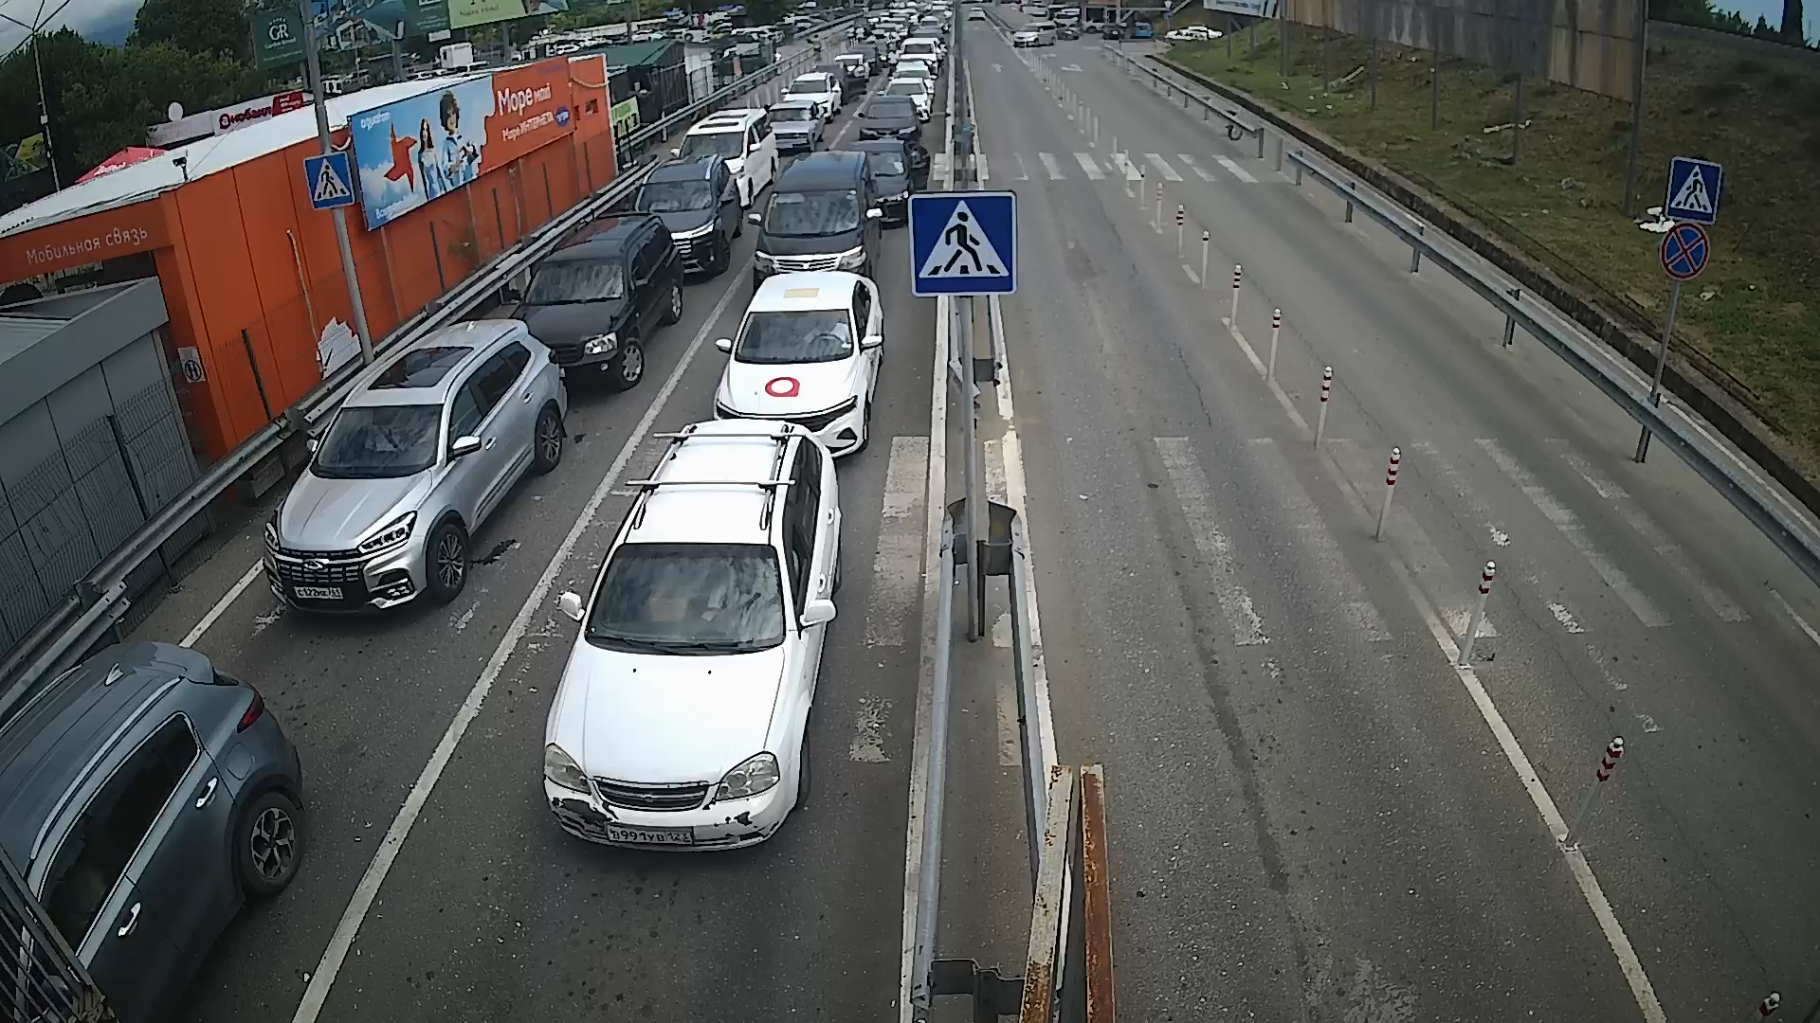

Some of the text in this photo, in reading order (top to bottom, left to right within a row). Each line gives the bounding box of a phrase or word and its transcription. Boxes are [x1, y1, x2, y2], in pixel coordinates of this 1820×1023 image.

[497, 87, 534, 116] Море
[26, 227, 148, 265] Мобильная связь
